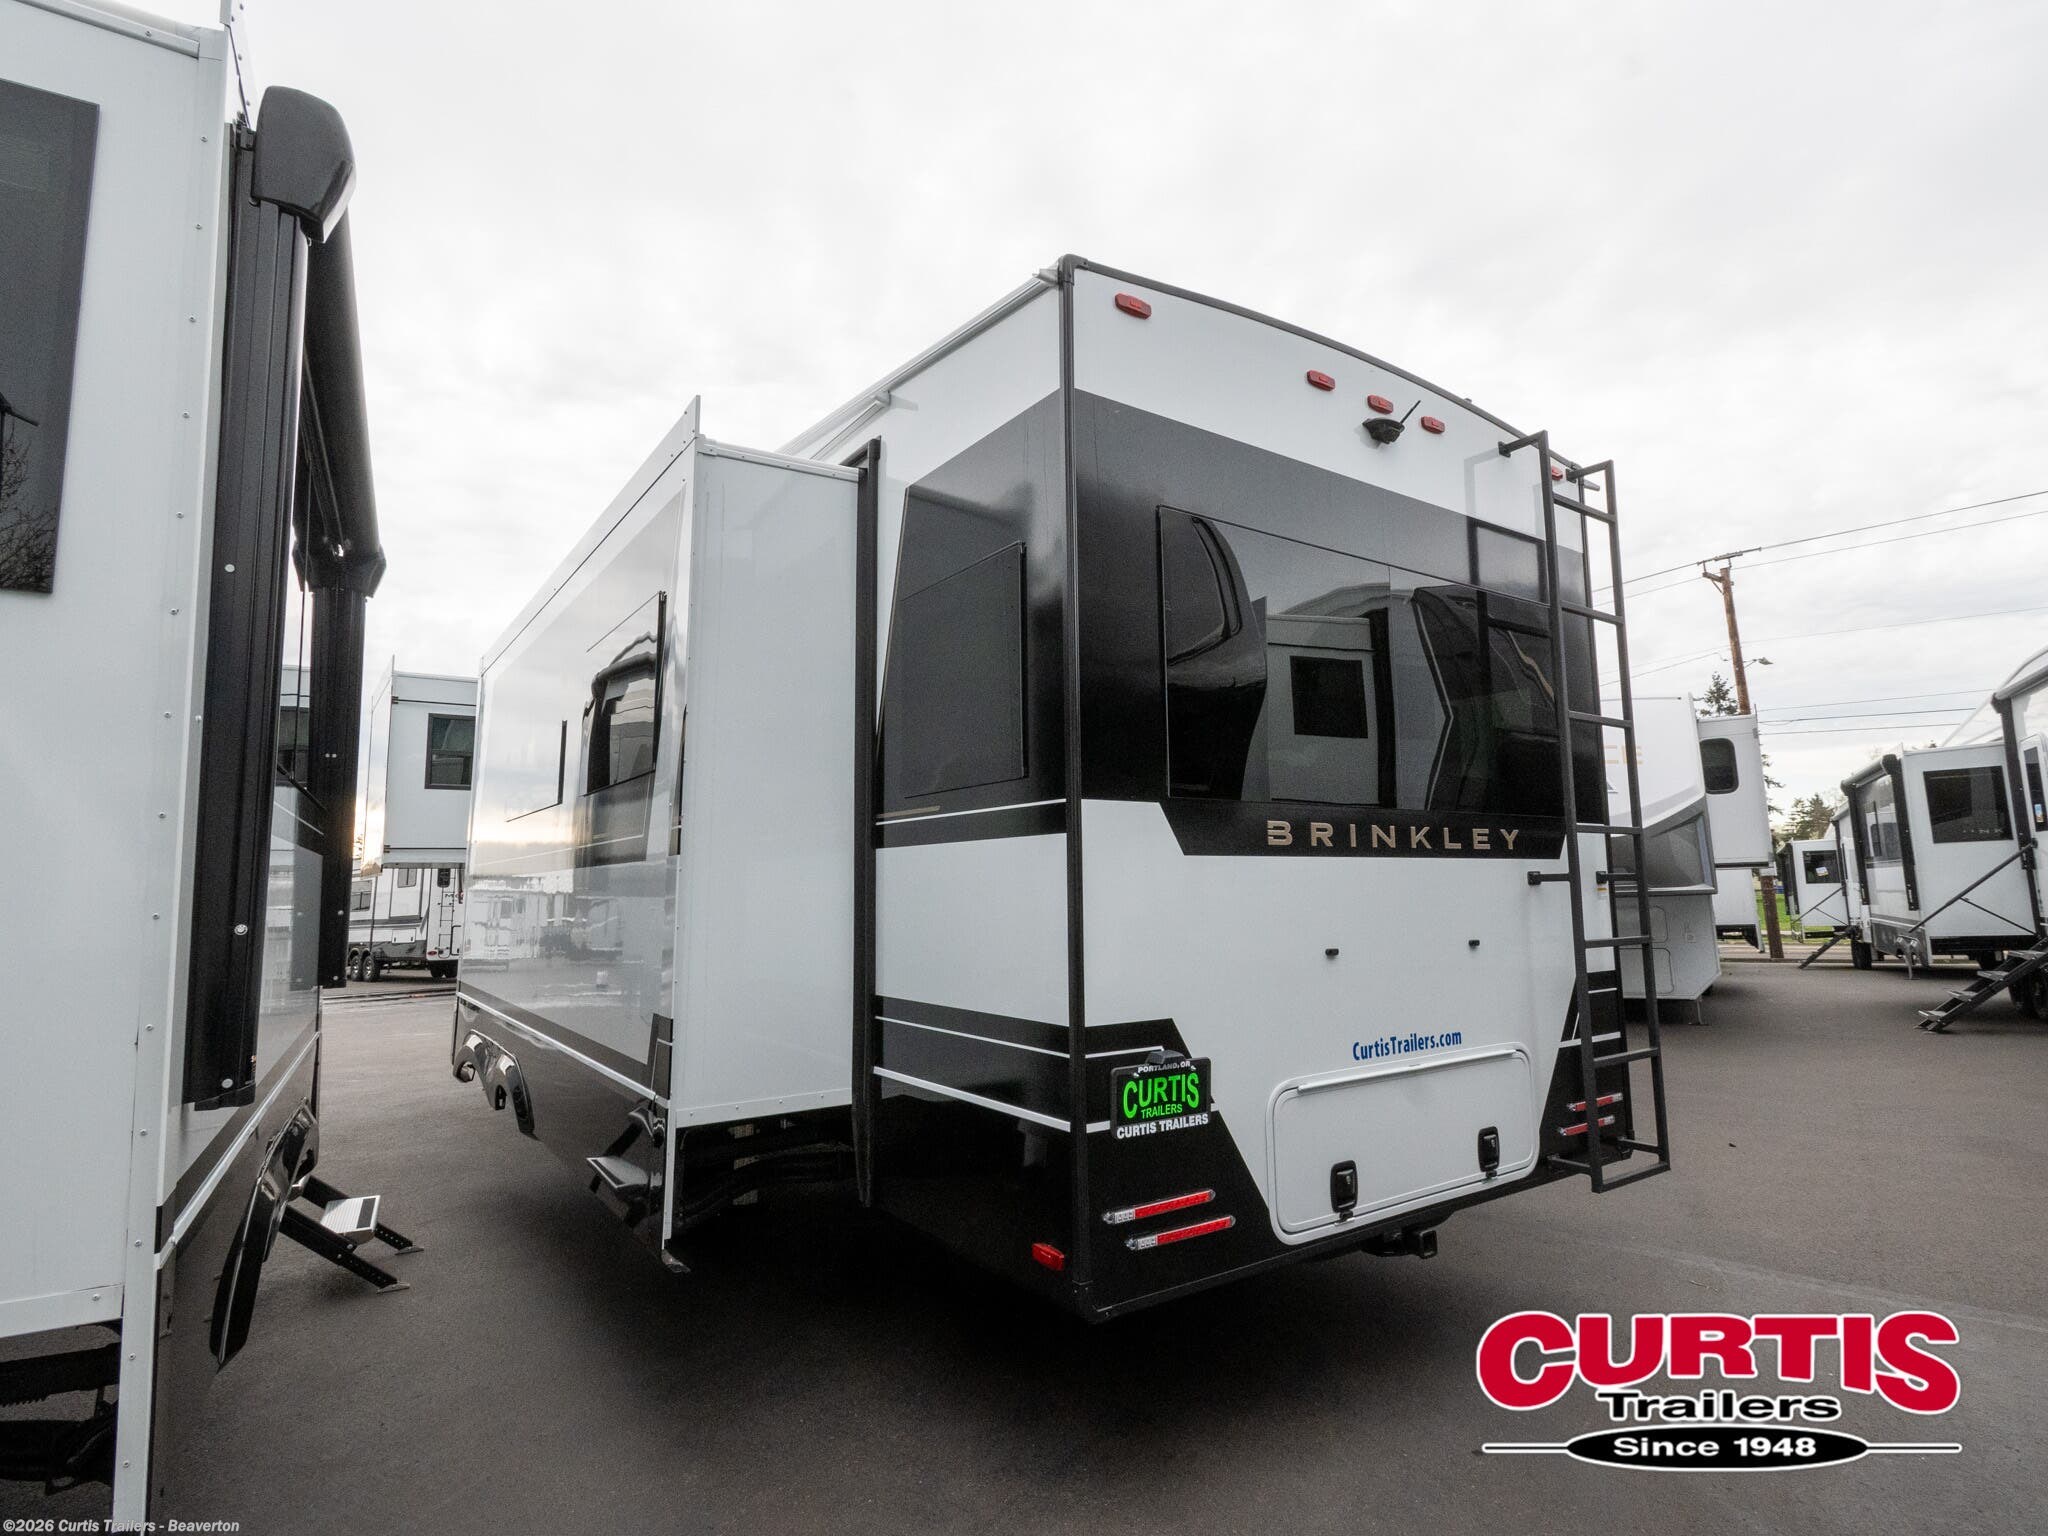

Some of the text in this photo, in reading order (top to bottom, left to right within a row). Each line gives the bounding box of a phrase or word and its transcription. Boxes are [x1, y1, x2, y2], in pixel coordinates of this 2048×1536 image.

[1267, 820, 1519, 850] BRINKLEY
[1353, 1031, 1462, 1060] CurtisTrailers.com
[1180, 1060, 1191, 1068] OR
[1123, 1073, 1199, 1119] CURTIS
[1141, 1103, 1183, 1119] TRAILERS
[1116, 1113, 1209, 1139] CURTIS TRAILERS
